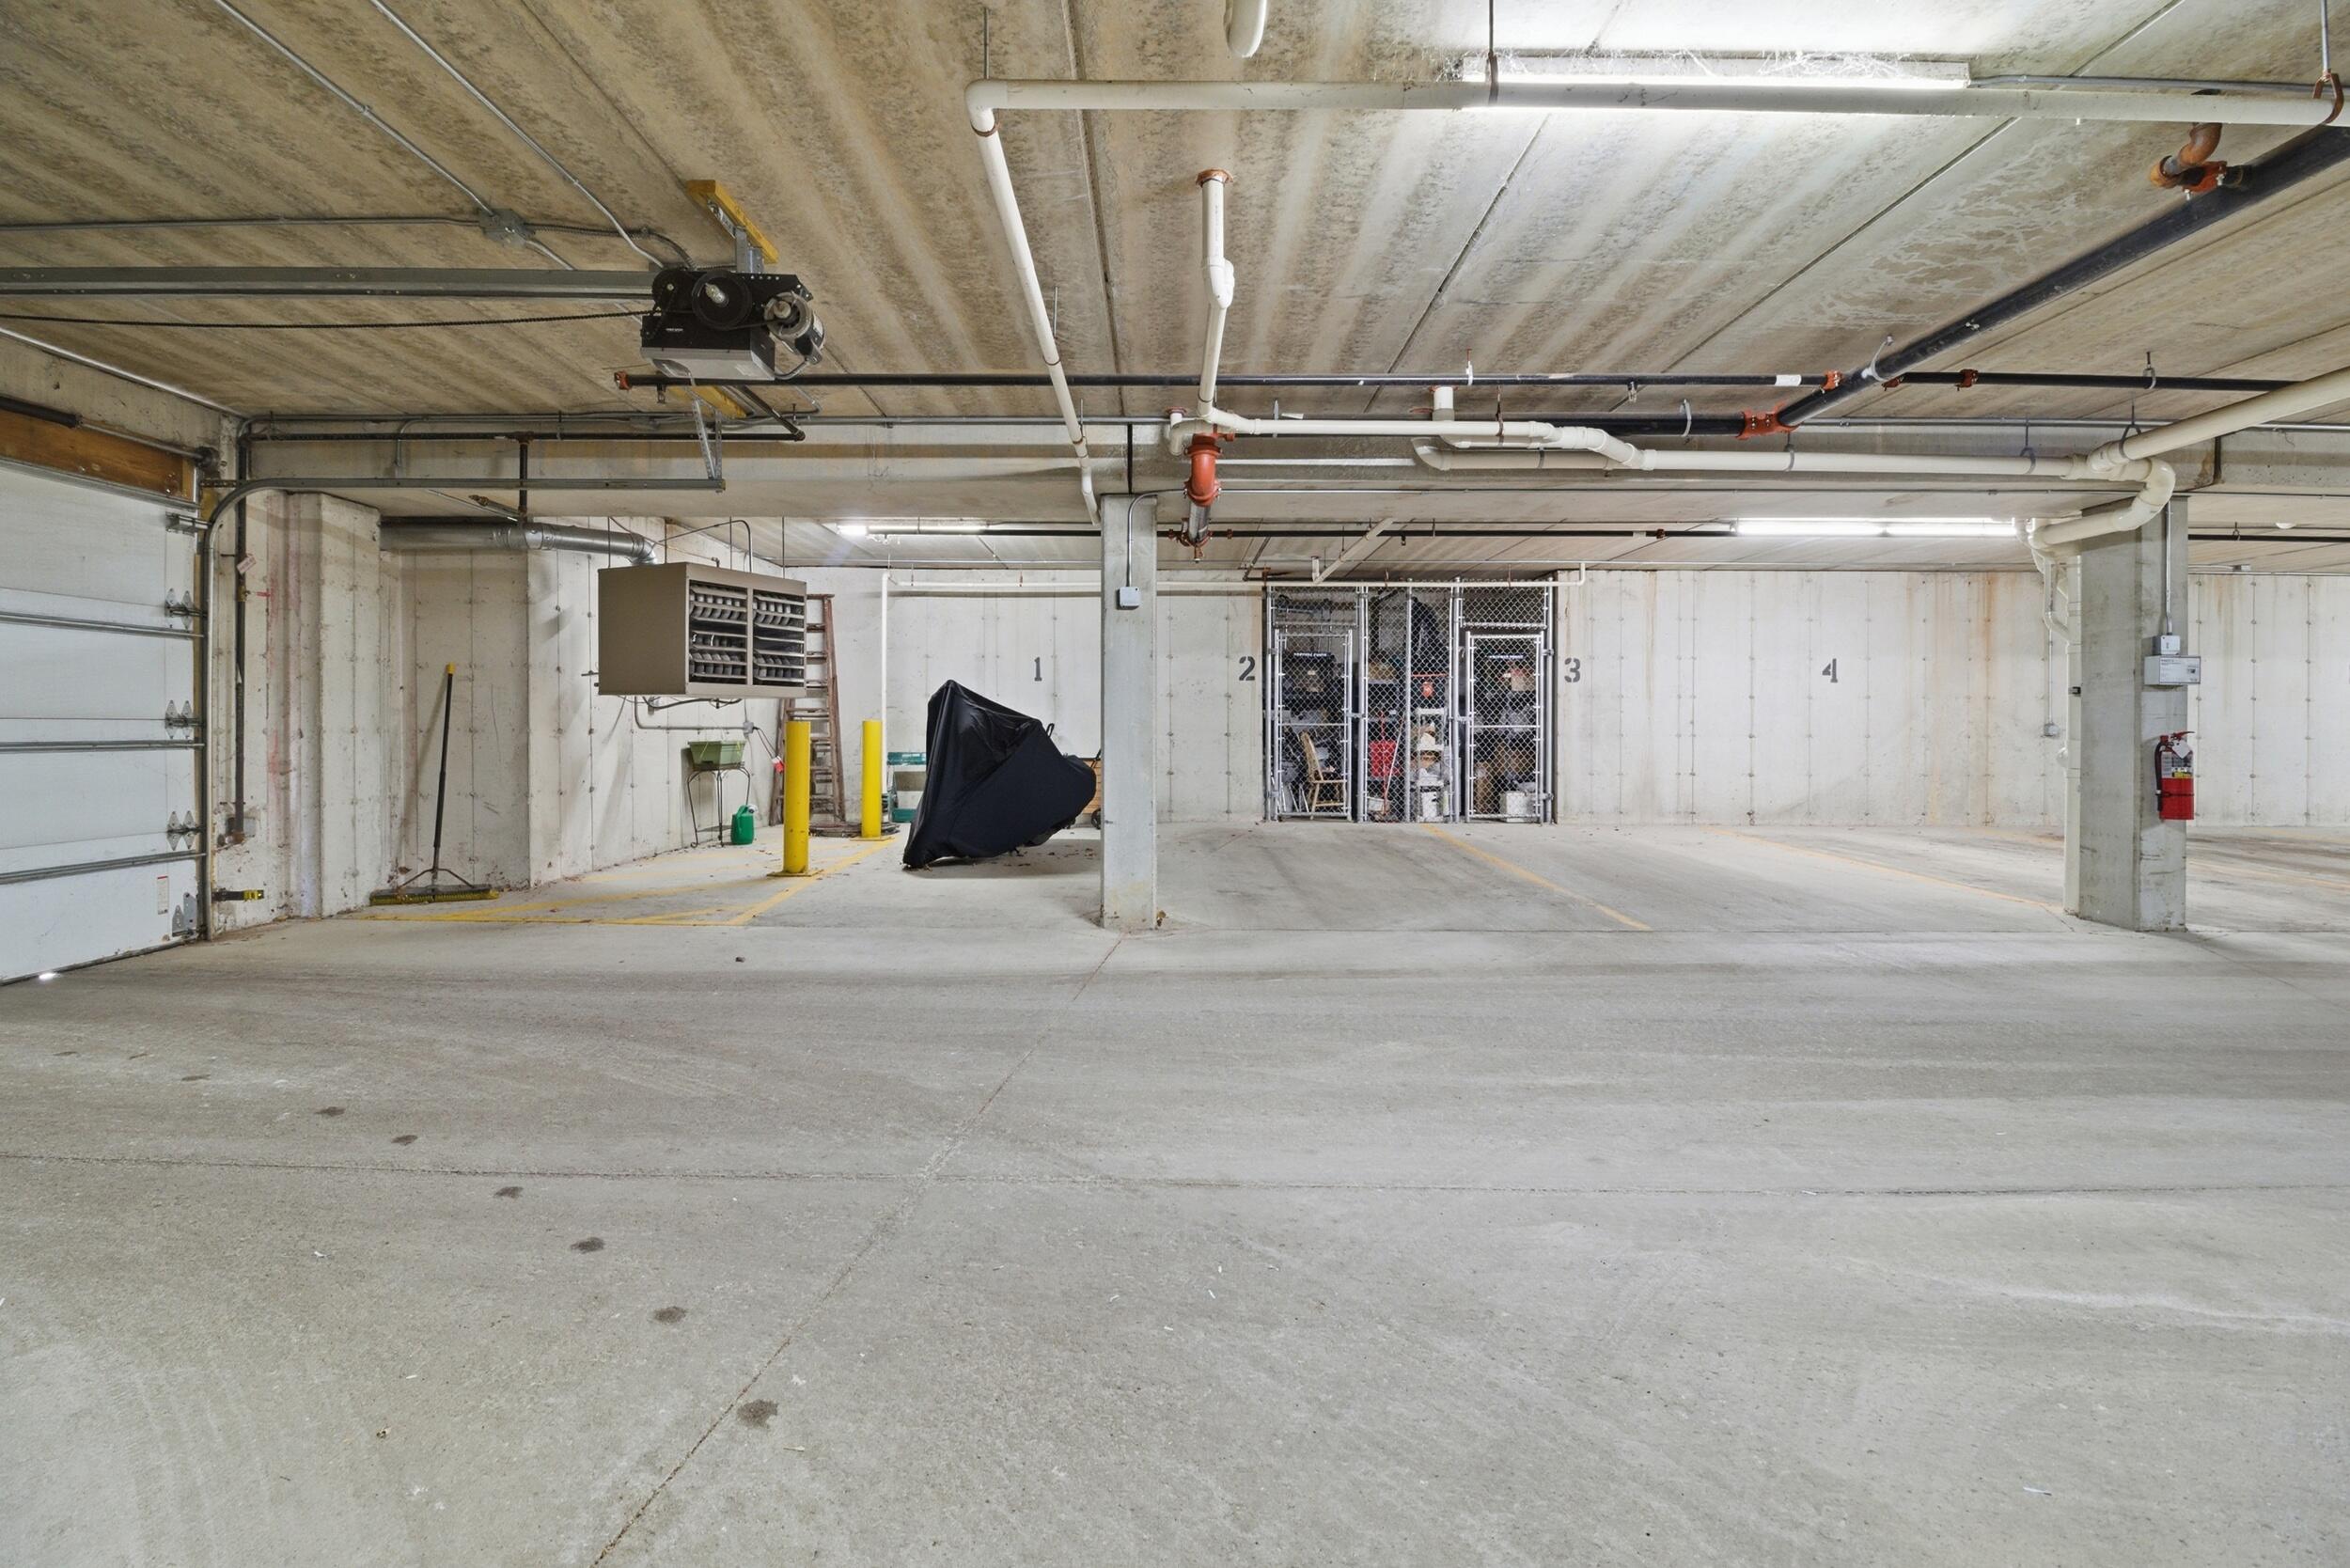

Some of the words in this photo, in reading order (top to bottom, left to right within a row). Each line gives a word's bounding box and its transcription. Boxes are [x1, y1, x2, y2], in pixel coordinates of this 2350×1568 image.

[1034, 657, 1042, 682] 1
[1239, 656, 1257, 682] 2
[1564, 657, 1581, 683] 3
[1822, 658, 1839, 683] 4
